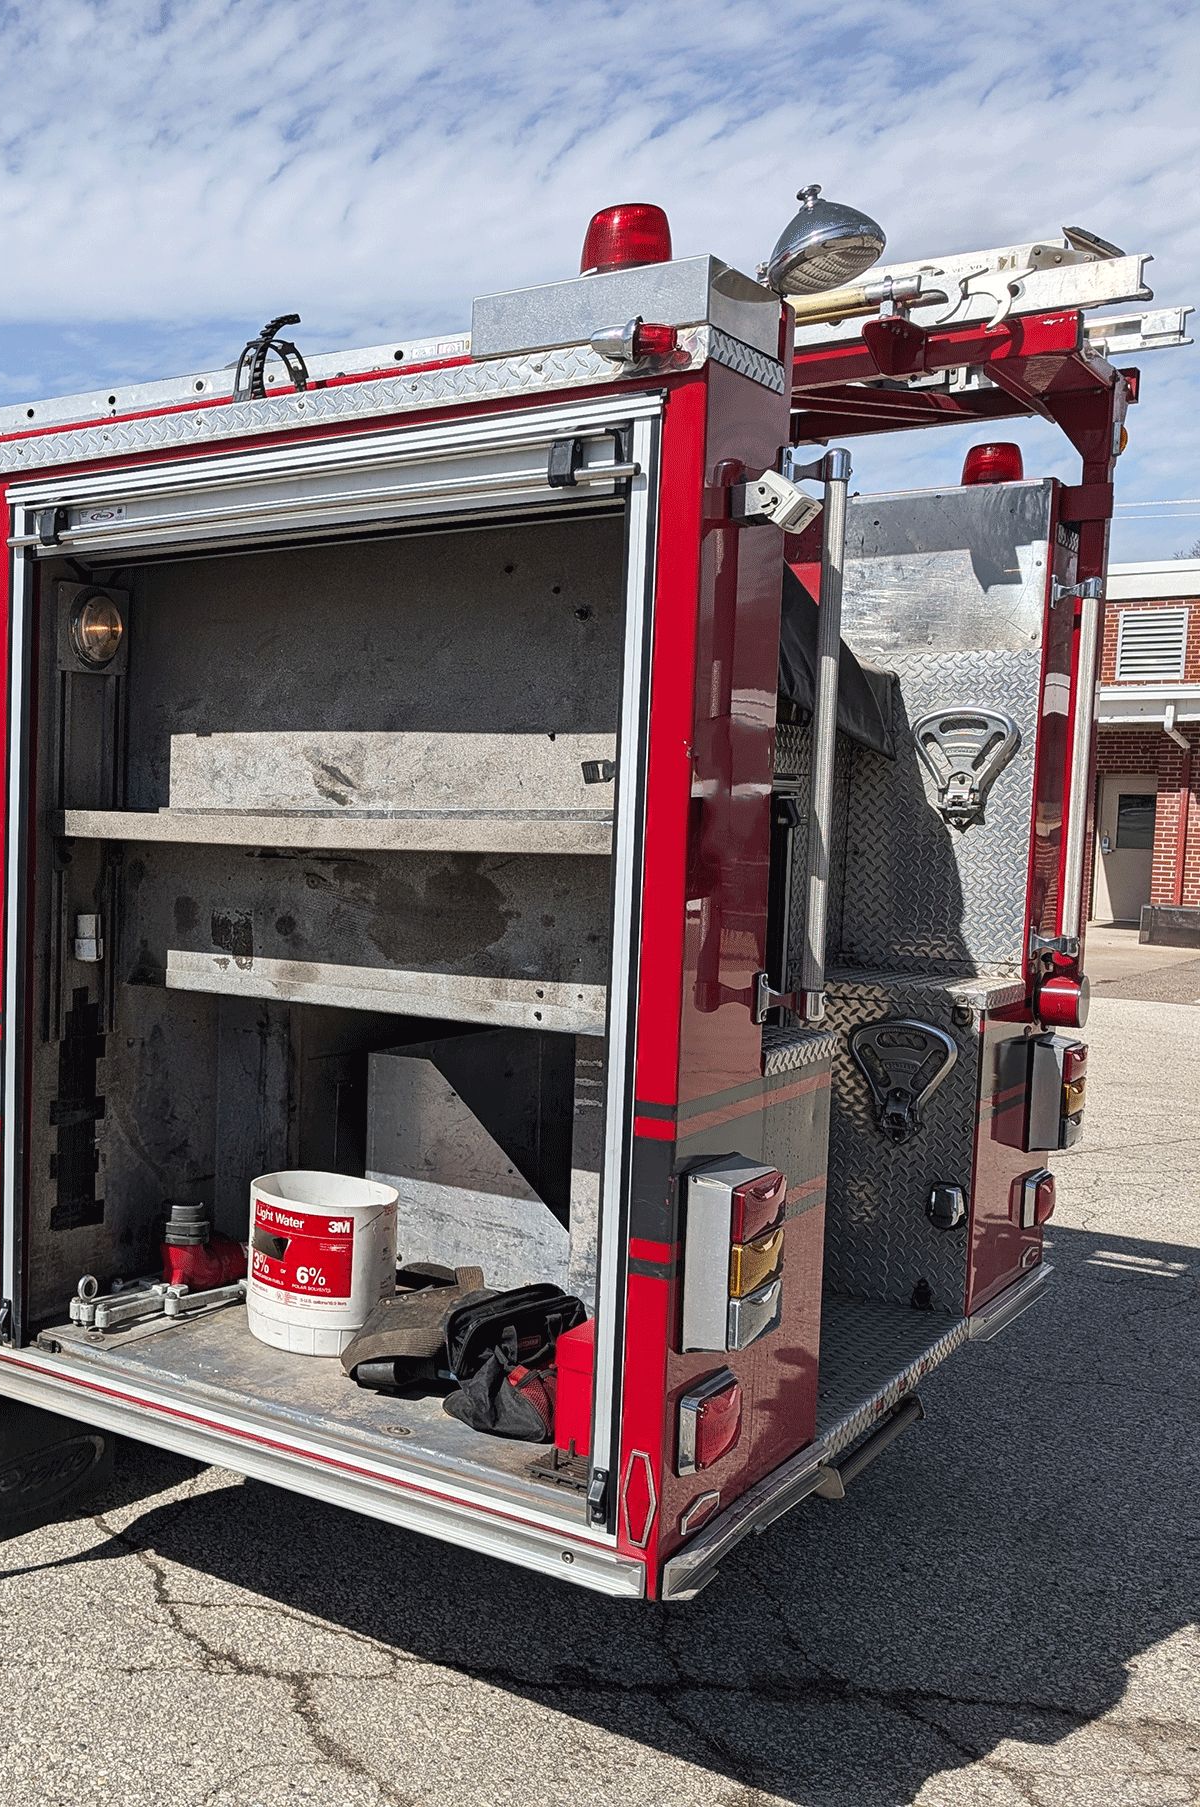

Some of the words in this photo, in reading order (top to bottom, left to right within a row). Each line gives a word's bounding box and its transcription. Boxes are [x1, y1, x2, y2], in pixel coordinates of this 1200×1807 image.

[256, 1206, 274, 1222] Light
[275, 1212, 305, 1229] Water
[328, 1221, 351, 1234] 3M
[253, 1252, 270, 1274] 3%
[296, 1266, 326, 1286] 6%
